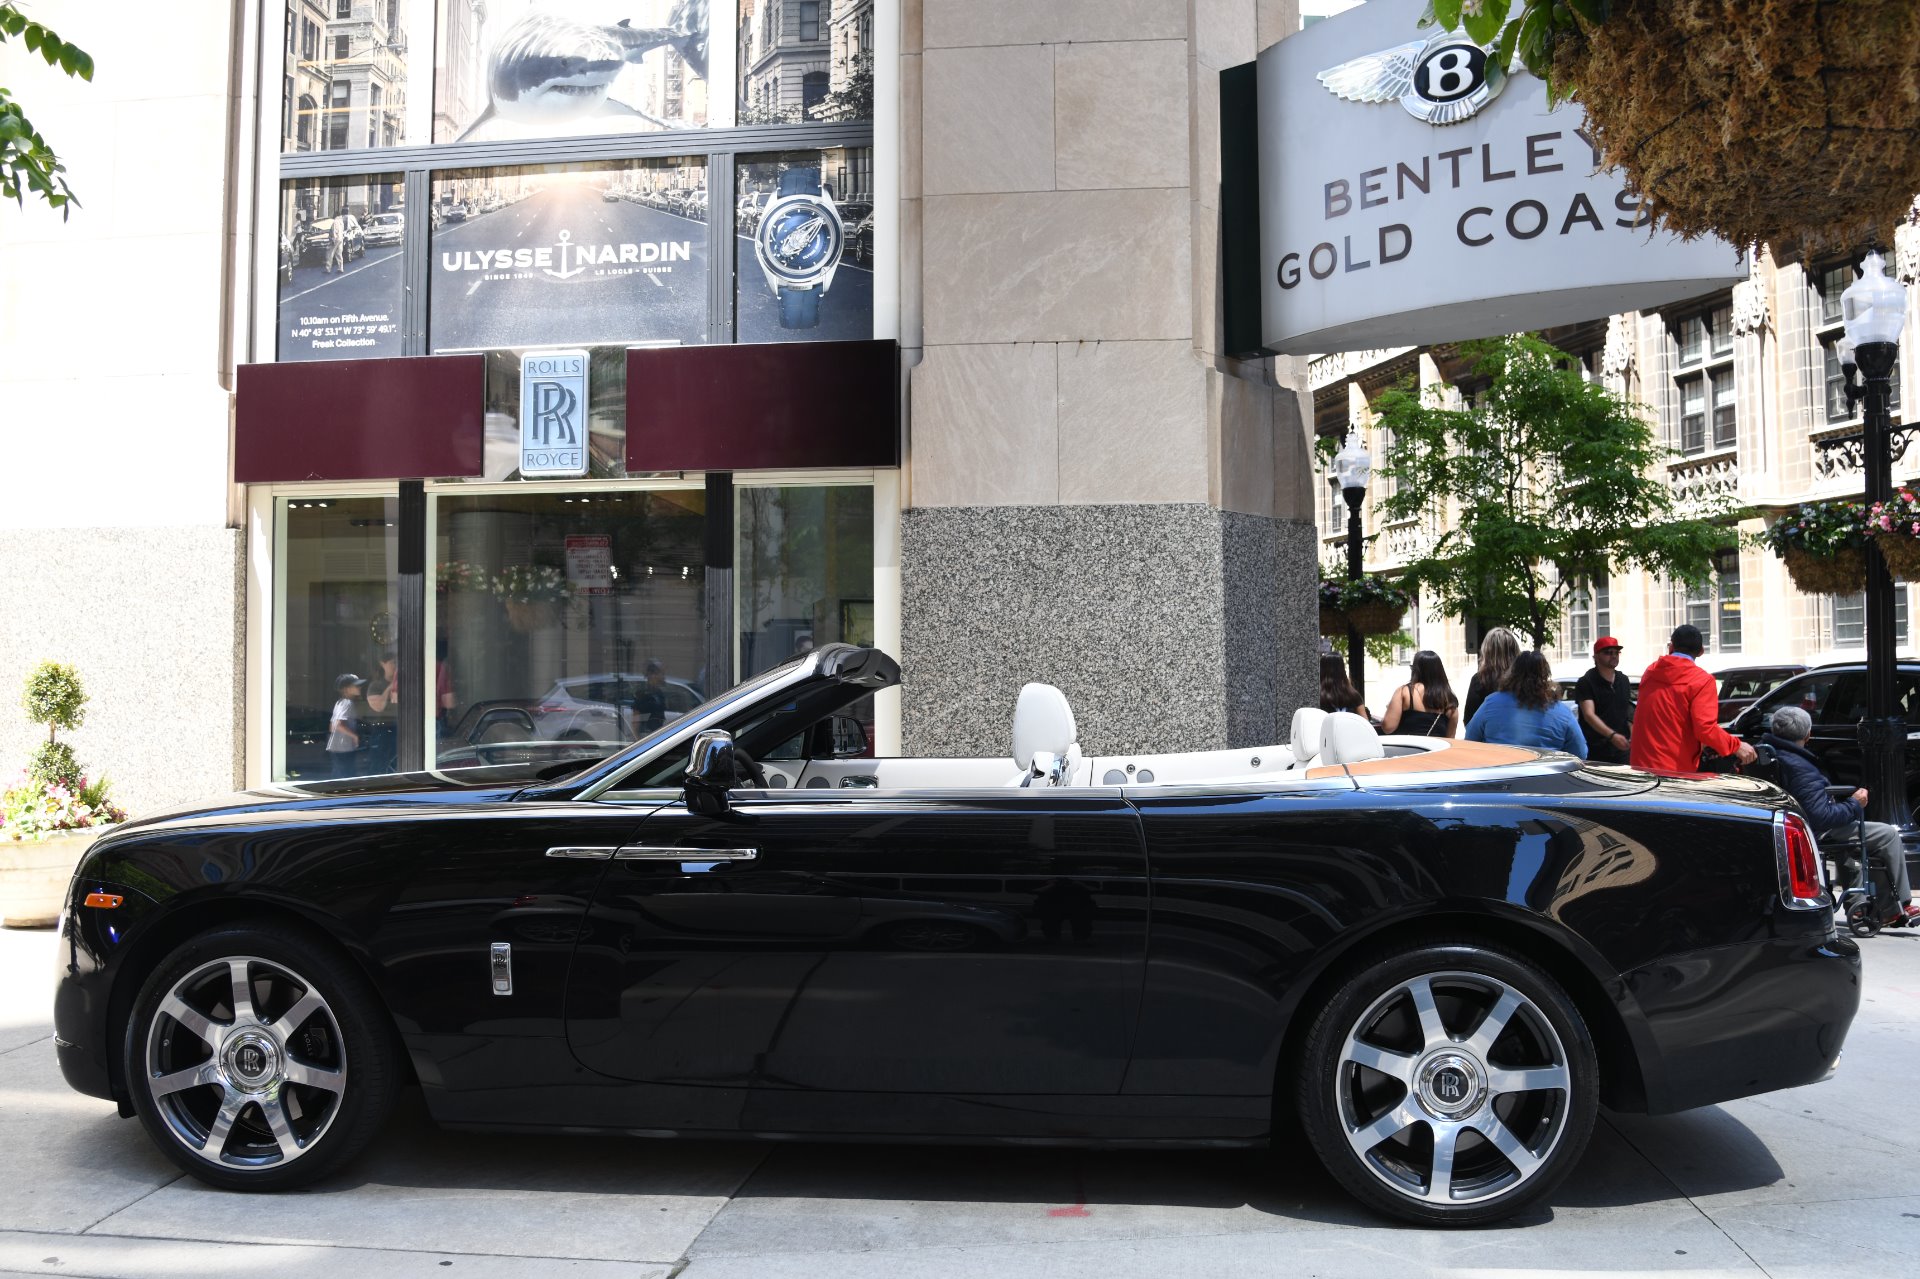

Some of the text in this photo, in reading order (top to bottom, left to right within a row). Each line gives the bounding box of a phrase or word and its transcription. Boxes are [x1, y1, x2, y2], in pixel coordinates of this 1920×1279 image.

[1427, 48, 1474, 98] B
[1277, 190, 1652, 290] GOLD COAS
[442, 241, 691, 272] ULYSSE NARDIN
[330, 316, 340, 324] on
[341, 314, 359, 323] Fifth
[335, 337, 376, 348] Collection
[528, 359, 580, 374] ROLLS
[532, 381, 577, 445] RR
[527, 452, 579, 467] ROYCE
